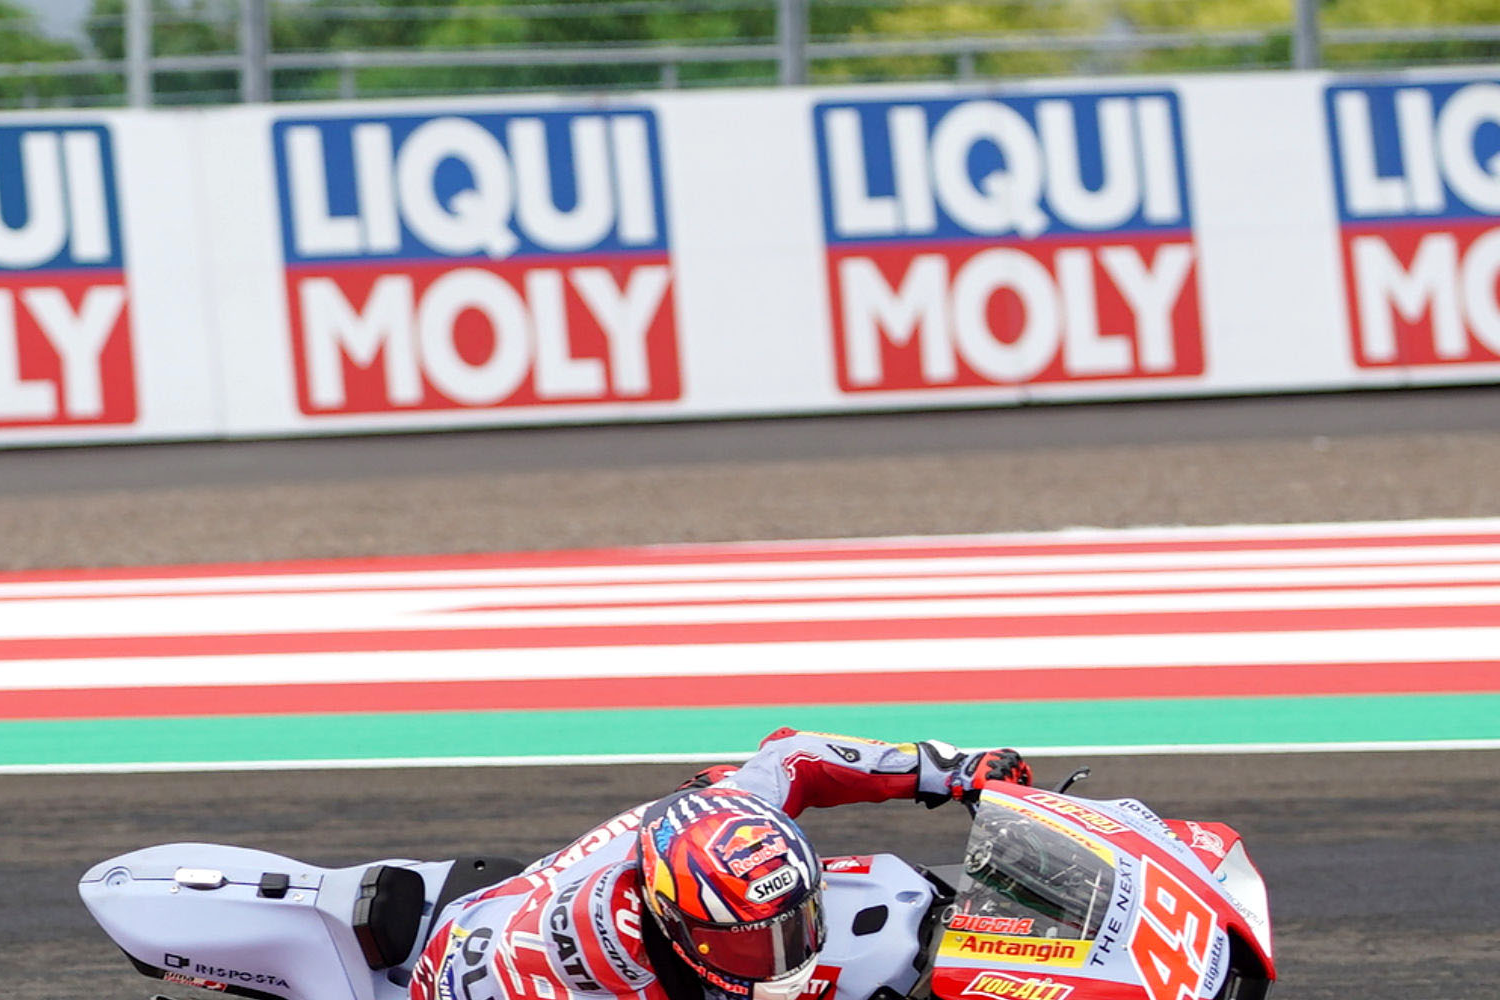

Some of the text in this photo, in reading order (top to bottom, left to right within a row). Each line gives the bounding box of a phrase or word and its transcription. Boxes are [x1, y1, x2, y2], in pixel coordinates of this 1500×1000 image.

[284, 115, 660, 259] LIQUI
[823, 96, 1183, 239] LIQUI
[300, 265, 673, 410] MOLY
[837, 243, 1197, 385] MOLY
[731, 910, 796, 933] GIVES YOU
[753, 871, 794, 899] SHOEI
[1090, 857, 1133, 968] THE NEXT
[195, 963, 290, 988] RISPOSTA
[959, 935, 1076, 962] Antangin
